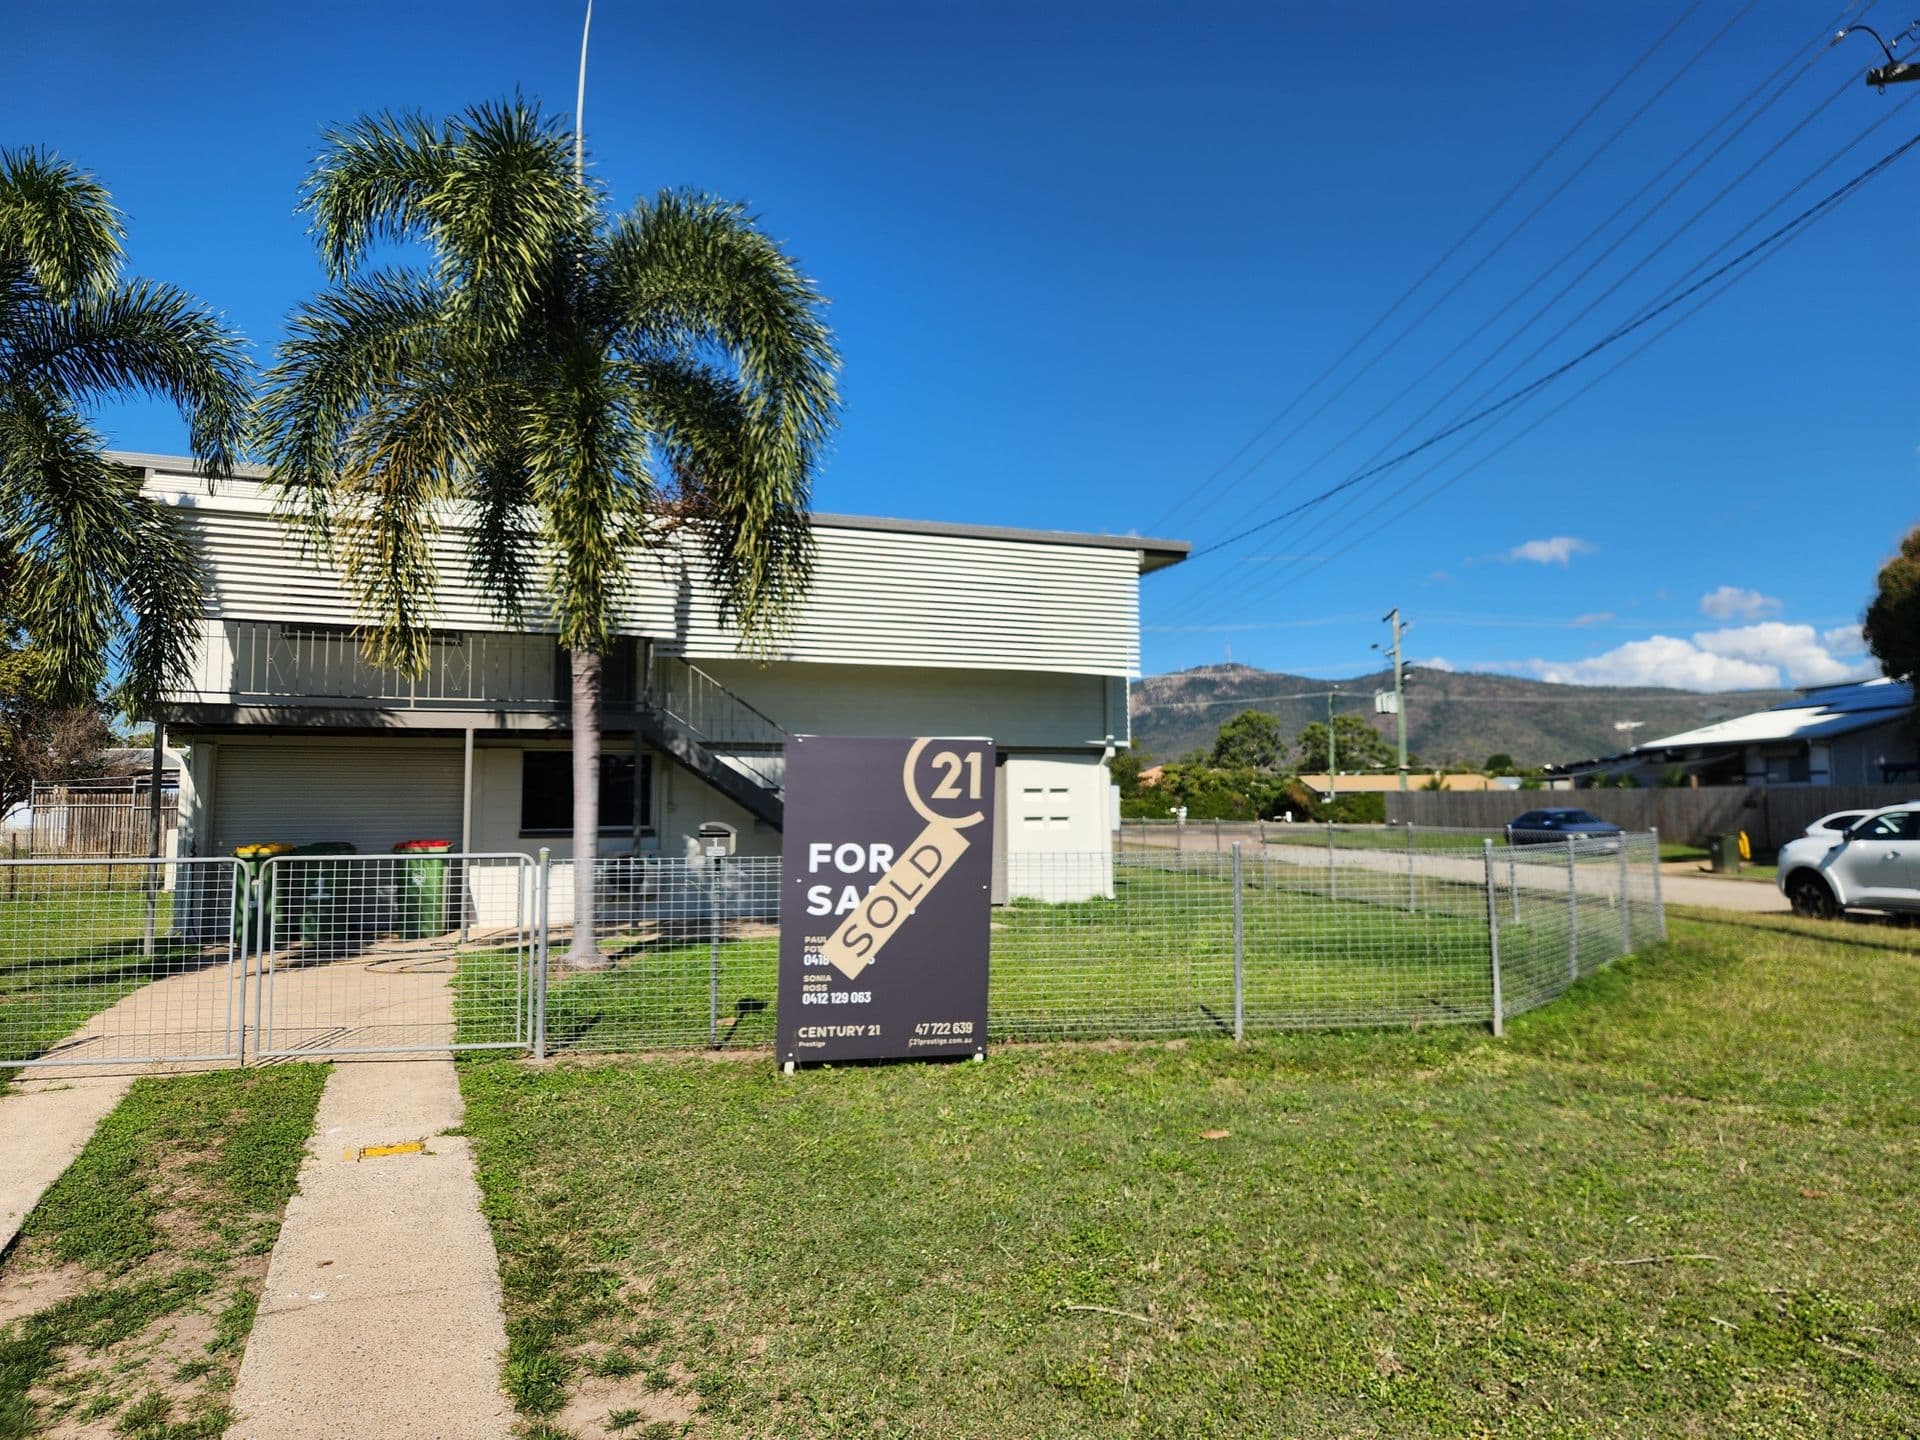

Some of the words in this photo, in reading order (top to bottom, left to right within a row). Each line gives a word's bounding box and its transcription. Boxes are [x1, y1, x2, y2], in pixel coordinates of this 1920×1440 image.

[808, 843, 895, 874] FOR
[842, 845, 942, 957] SOLD
[803, 974, 832, 983] SONIA
[802, 984, 828, 992] ROSS
[802, 993, 828, 1005] 0412
[830, 992, 849, 1004] 129
[798, 1025, 865, 1038] CENTURY
[867, 1024, 881, 1036] 21
[915, 1023, 930, 1036] 47
[930, 1022, 951, 1035] 722
[952, 1021, 974, 1034] 639
